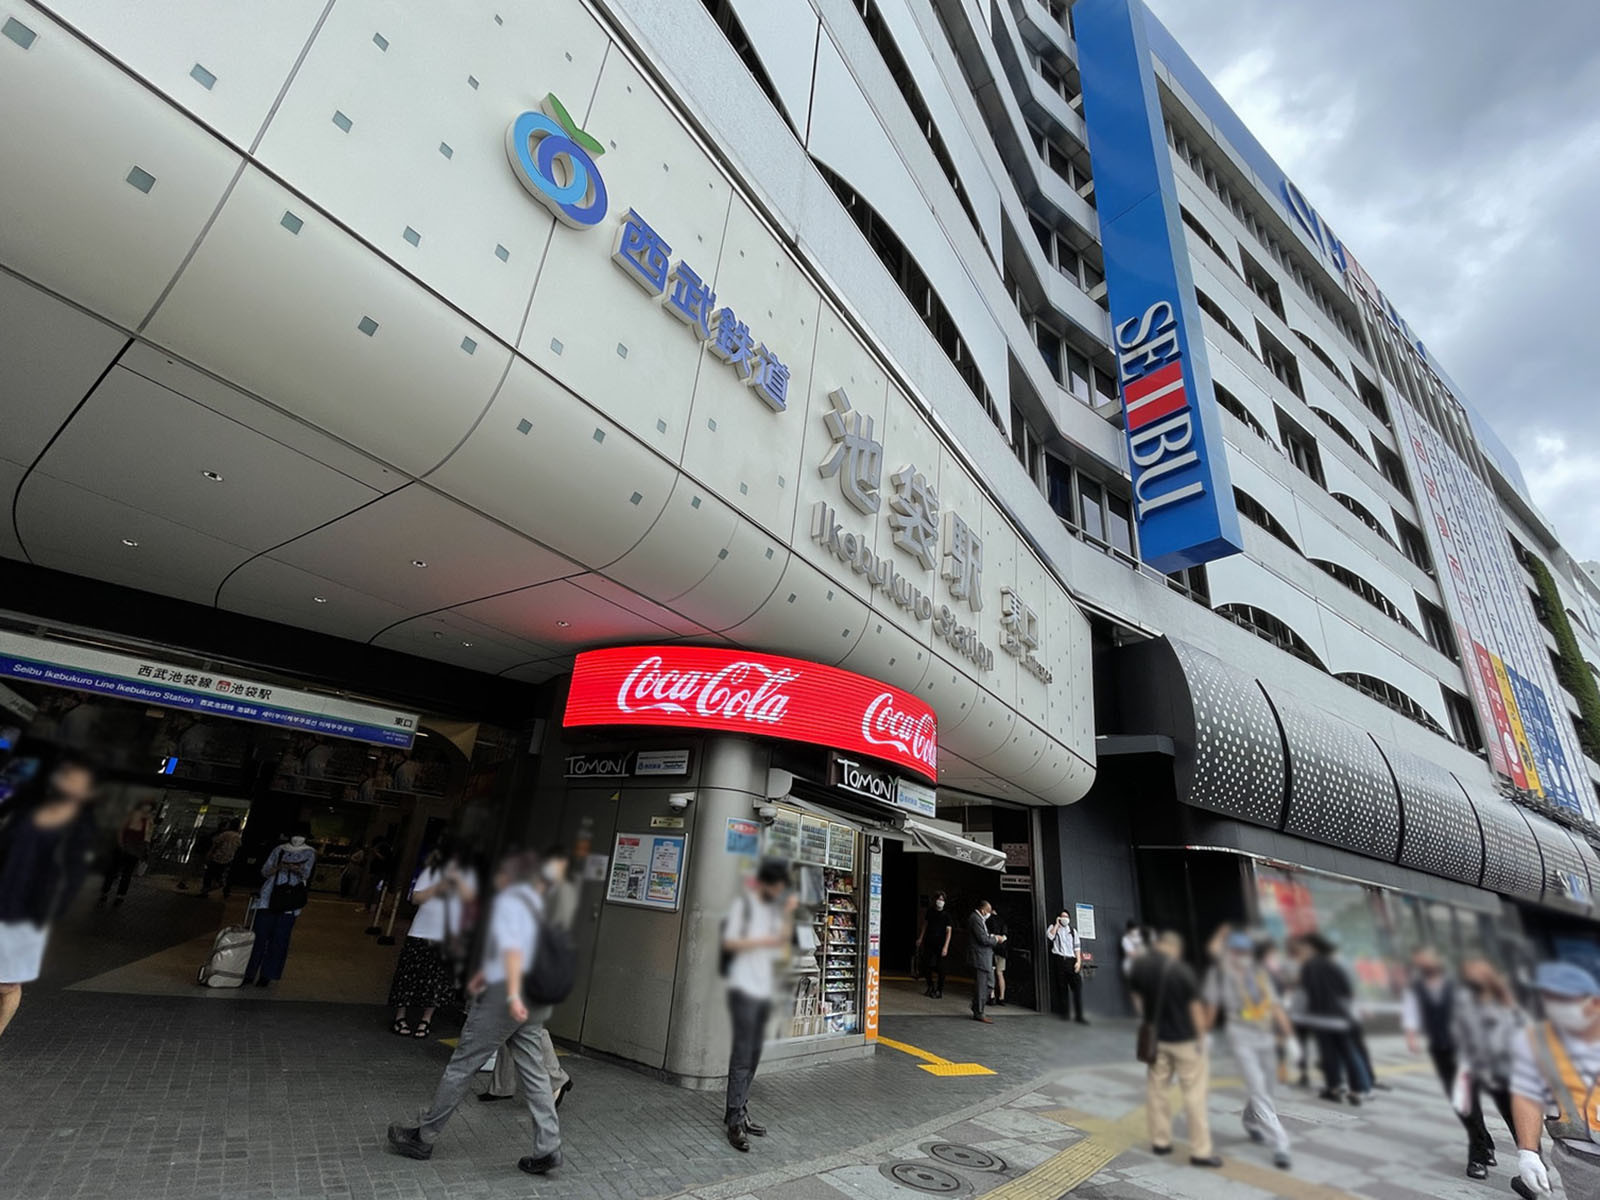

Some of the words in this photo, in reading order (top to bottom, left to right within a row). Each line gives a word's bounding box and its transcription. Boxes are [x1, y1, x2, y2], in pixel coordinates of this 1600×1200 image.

[613, 207, 792, 413] 西武鉄道
[1115, 300, 1206, 522] SEIBU
[819, 386, 983, 612] 池袋駅
[1000, 586, 1039, 651] 東口
[811, 501, 933, 621] Ikebukuro
[932, 604, 994, 672] Station
[13, 664, 42, 677] Seibu
[44, 671, 93, 686] Ikebukuro
[95, 679, 115, 690] Line
[117, 683, 162, 698] Ikebukuro
[163, 692, 195, 704] Station
[137, 664, 213, 689] 西武池袋線
[230, 682, 273, 700] 池袋駅
[617, 656, 803, 724] Coca-Cola
[393, 717, 413, 728] 東口
[837, 758, 900, 803] TOMONY
[867, 966, 879, 1029] たばこ
